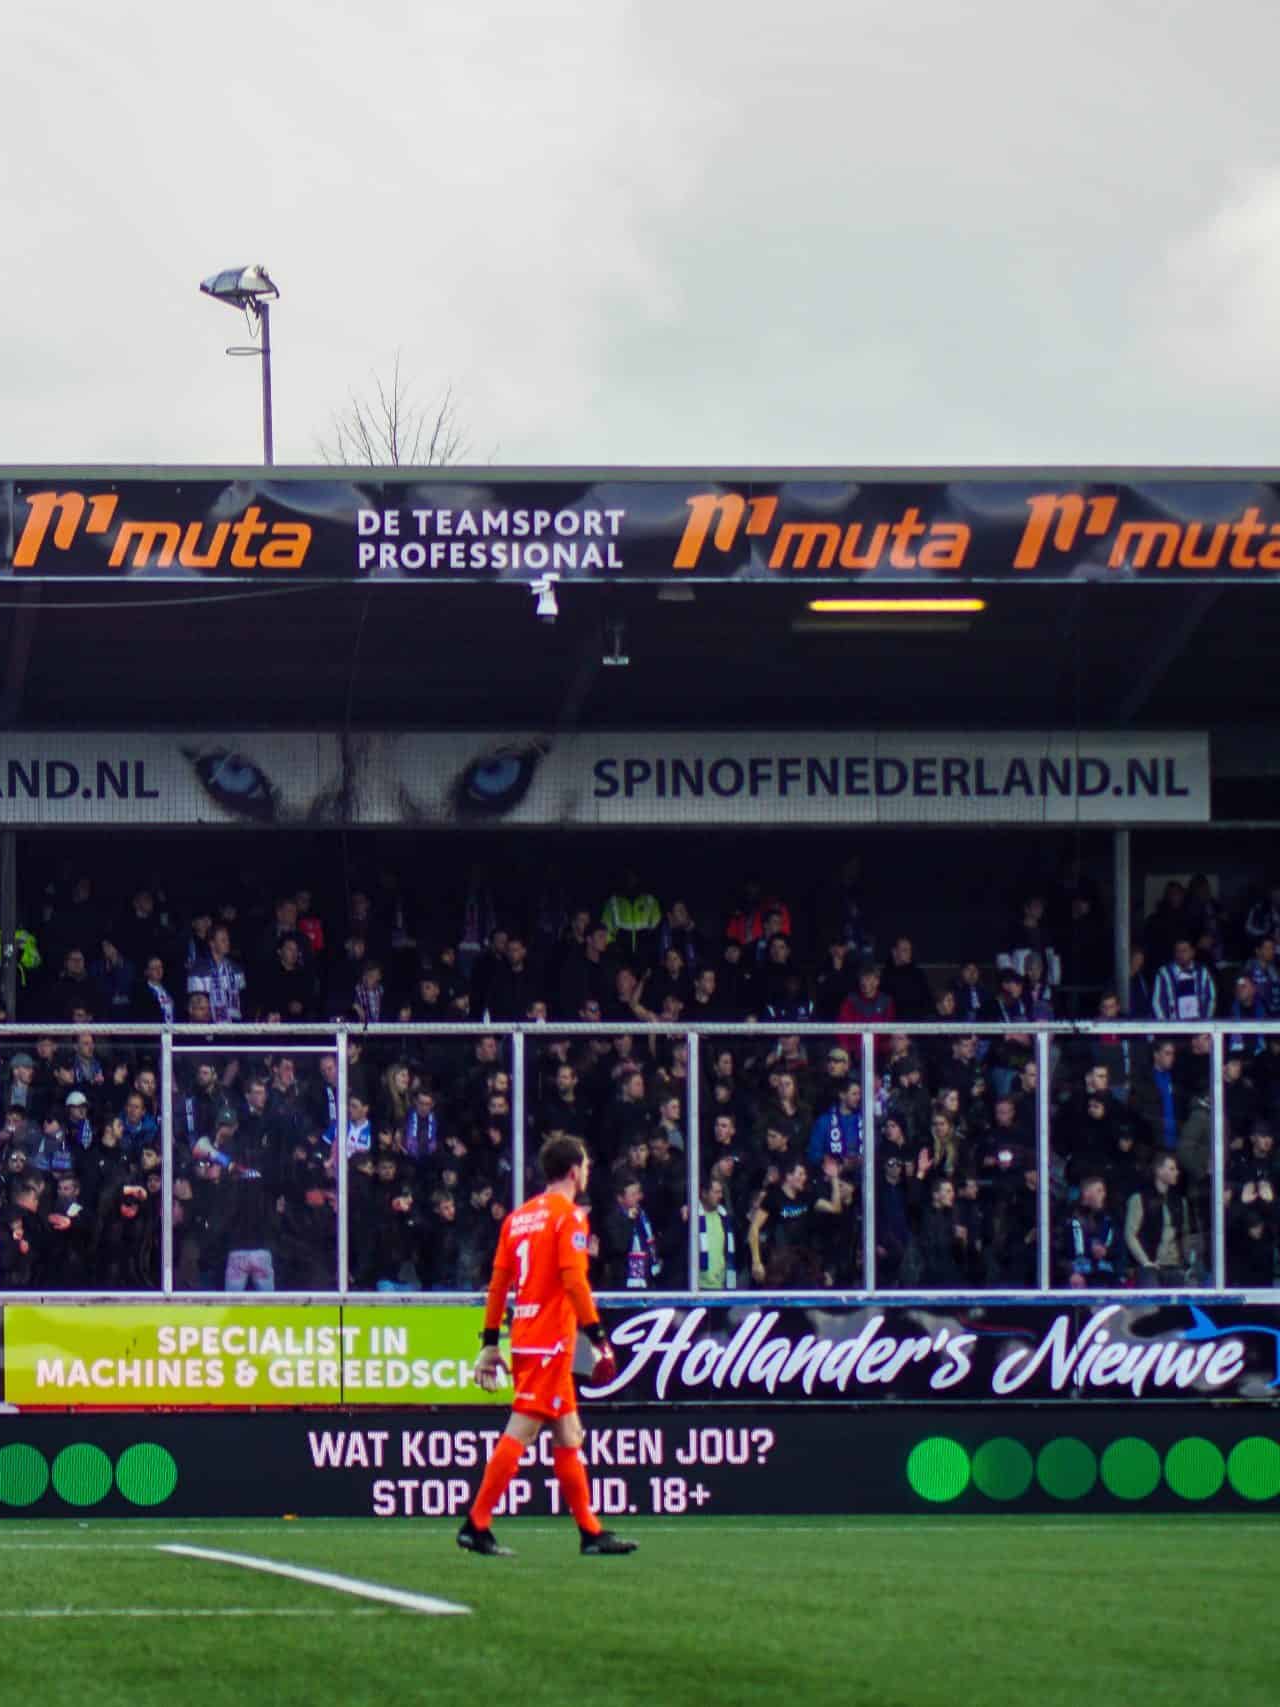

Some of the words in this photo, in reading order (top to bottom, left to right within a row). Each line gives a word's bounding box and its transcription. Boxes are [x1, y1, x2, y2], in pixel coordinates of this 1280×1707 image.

[108, 506, 313, 569] muta
[357, 509, 400, 536] DE
[412, 509, 625, 537] TEAMSPORT
[768, 508, 971, 569] muta
[358, 542, 624, 569] PROFESSIONAL
[592, 757, 1189, 798] SPINOFFNEDERLAND.NL
[156, 1327, 359, 1356] SPECIALIST
[371, 1327, 408, 1355] IN
[580, 1306, 978, 1400] Hollander's
[991, 1304, 1246, 1397] Nieuwe
[36, 1358, 225, 1388] MACHINES
[234, 1358, 259, 1388] &
[308, 1430, 390, 1468] WAT
[401, 1430, 502, 1468] KOST
[675, 1427, 775, 1465] JOU?
[371, 1478, 471, 1517] STOP
[649, 1476, 712, 1514] 18+
